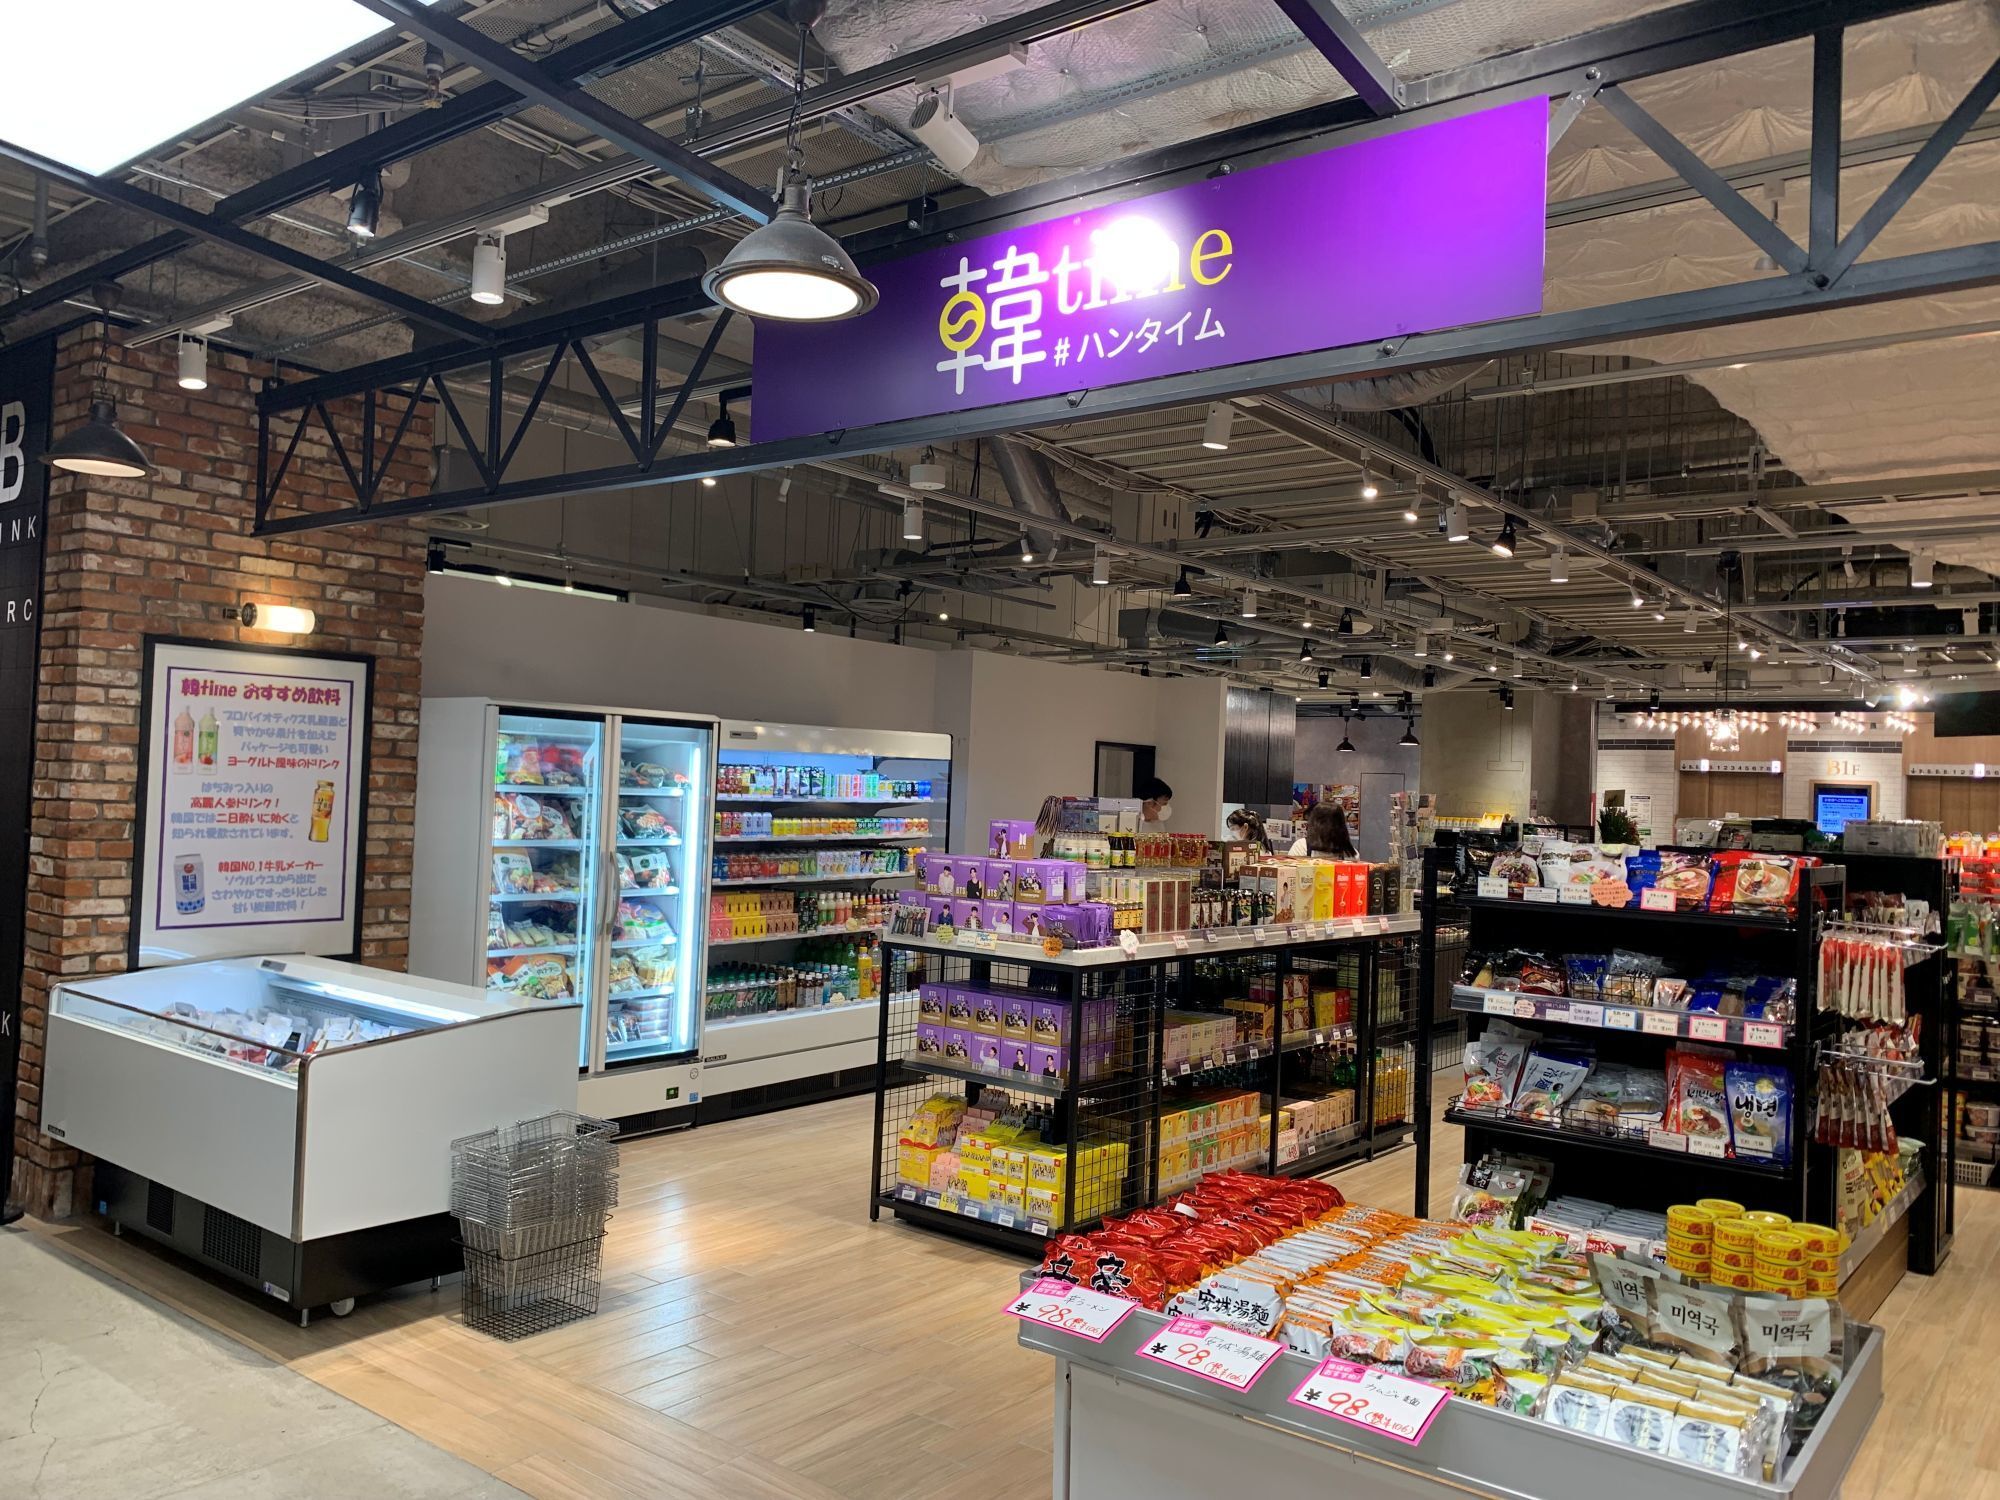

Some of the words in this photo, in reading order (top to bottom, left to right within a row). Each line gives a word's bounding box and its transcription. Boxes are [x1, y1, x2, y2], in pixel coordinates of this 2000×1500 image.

[181, 678, 237, 697] 韓time
[243, 684, 341, 706] おすすめ飲料
[227, 756, 340, 770] ヨーグルト風味のドリンク
[201, 782, 273, 793] はちみつ入りの
[170, 812, 300, 825] 韓国では二日酔いに効くと
[1687, 1088, 1726, 1104] 비빔냉
[1735, 1095, 1778, 1118] 냉면
[1092, 1252, 1132, 1294] 辛
[1671, 1304, 1720, 1337] 미역국
[1762, 1323, 1813, 1342] 미역국
